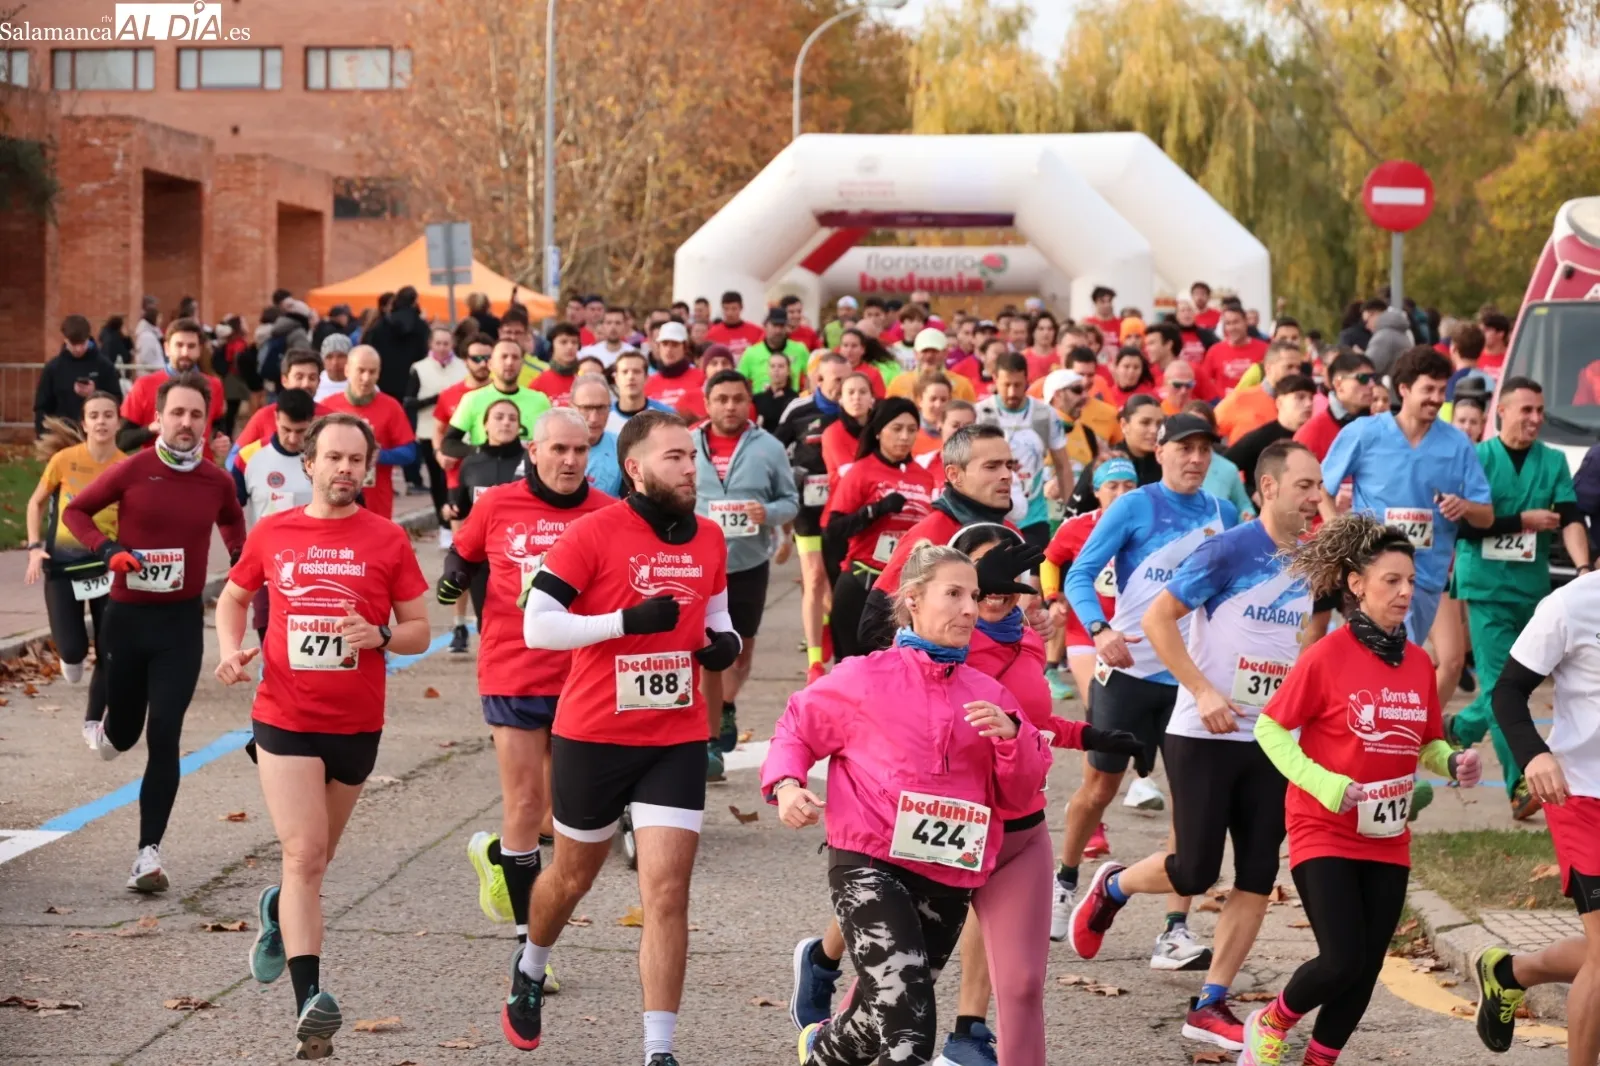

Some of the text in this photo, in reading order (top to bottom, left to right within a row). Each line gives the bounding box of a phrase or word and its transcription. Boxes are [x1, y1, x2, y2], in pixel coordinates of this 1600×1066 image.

[859, 271, 985, 293] bedunia
[720, 513, 749, 527] 132
[1494, 534, 1525, 550] 224
[307, 545, 355, 560] ¡Corre sin
[681, 552, 693, 564] sin
[138, 564, 173, 582] 397
[298, 560, 366, 577] resistencias!
[1143, 566, 1174, 583] ARA
[82, 575, 110, 592] 370
[1243, 604, 1303, 627] ARABAY
[300, 635, 344, 657] 471
[618, 655, 691, 674] bedunia
[1238, 656, 1293, 677] beduni
[635, 672, 679, 697] 188
[1407, 689, 1421, 705] sin
[900, 795, 988, 825] bedunia
[1373, 797, 1408, 824] 412
[912, 818, 966, 850] 424
